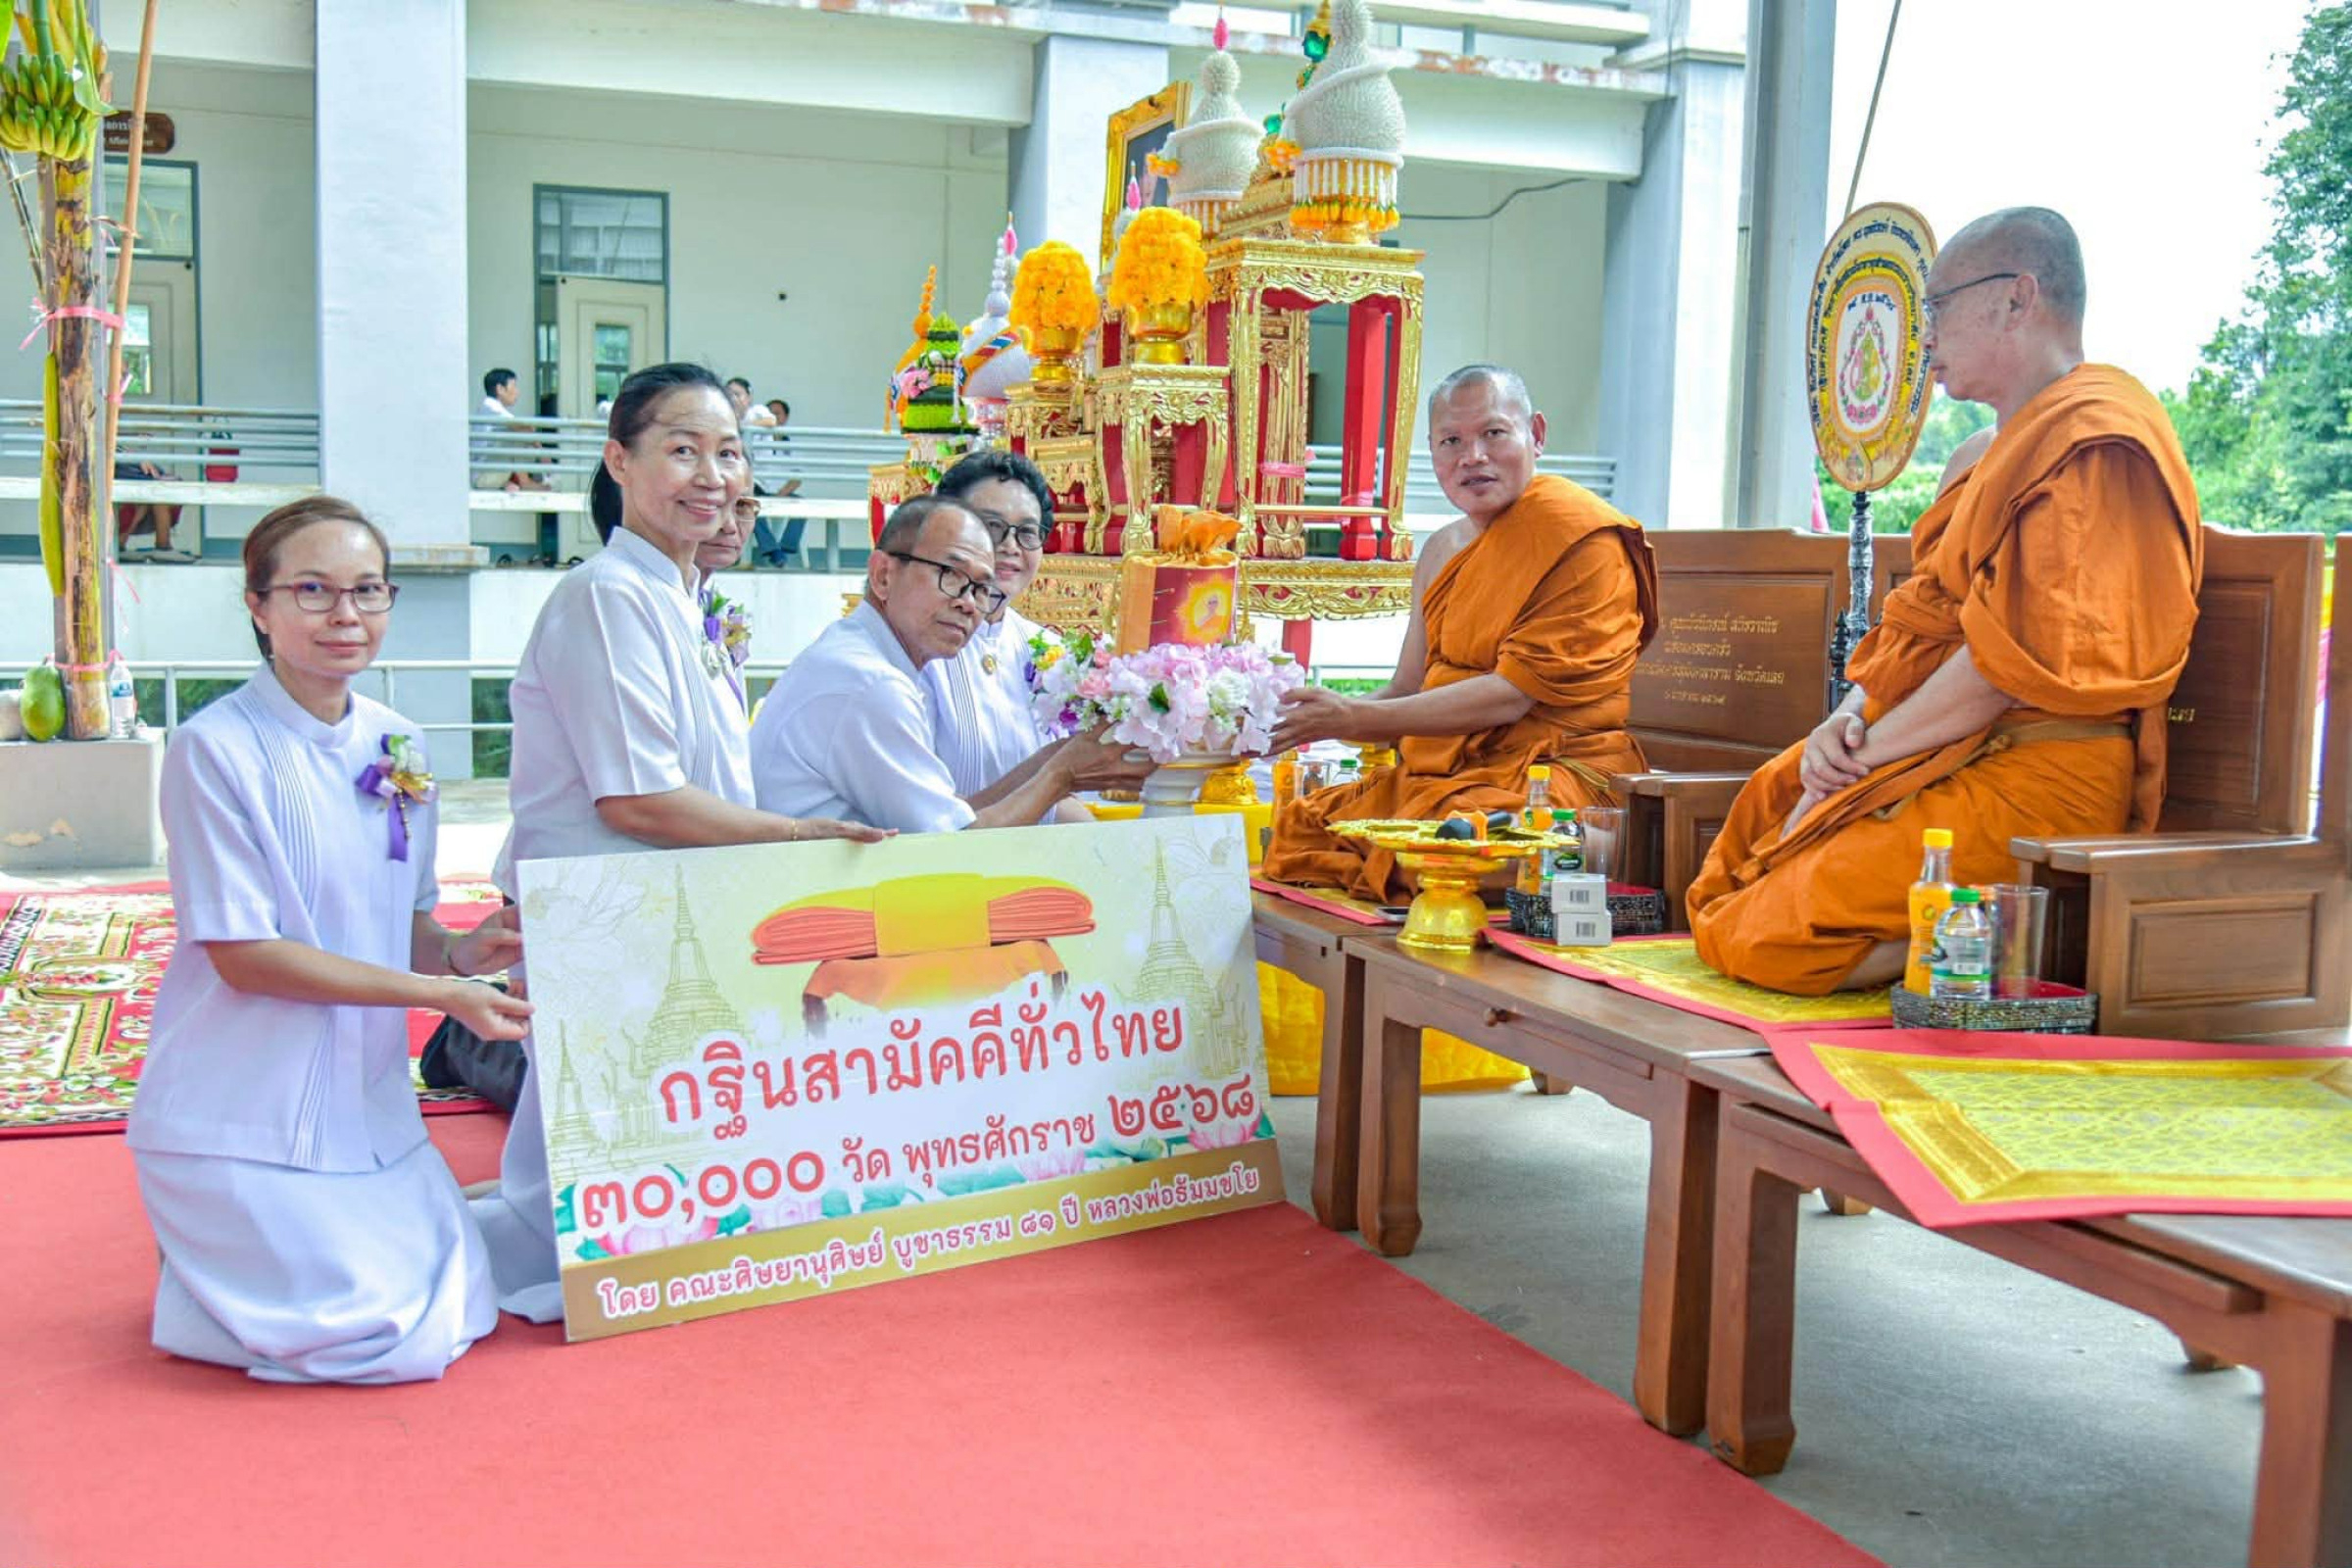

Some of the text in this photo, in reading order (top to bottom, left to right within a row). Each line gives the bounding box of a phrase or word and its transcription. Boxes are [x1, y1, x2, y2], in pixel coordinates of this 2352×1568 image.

[659, 982, 1184, 1141] กฐินสามัคคีทั่วไทย
[582, 1074, 1254, 1229] ๓๐,๐๐๐ วัด พุทธศักราช ๒๕๖๘
[599, 1165, 1260, 1315] โดย คณะศิษยานุศิษย์ บูชาธรรม ๘๑ ปี หลวงพ่อธัมมชโย
